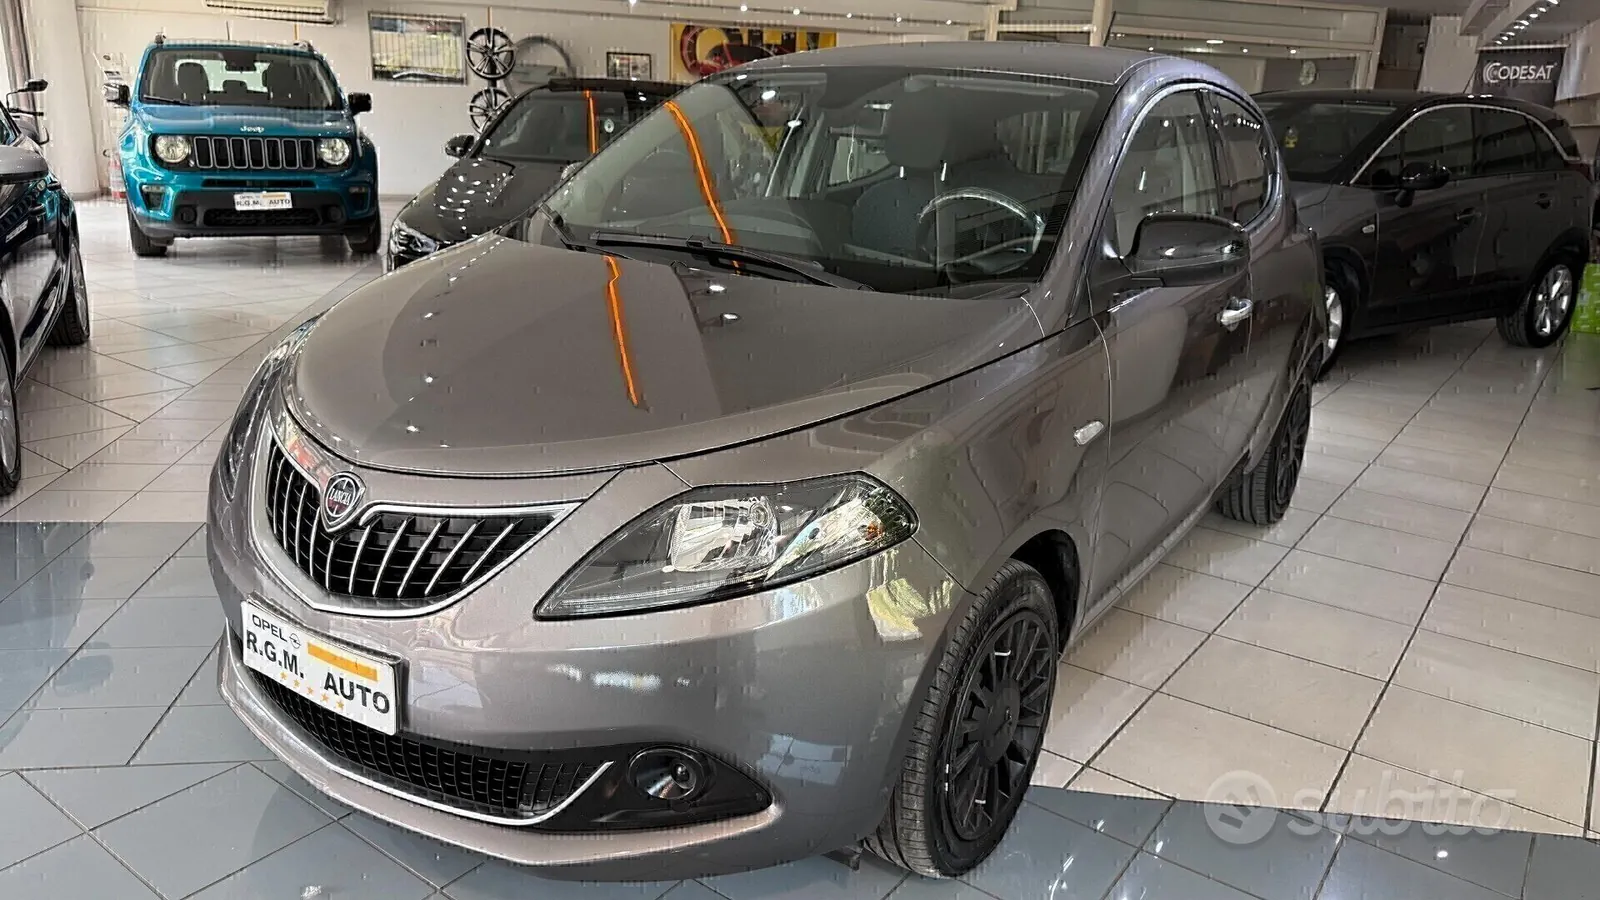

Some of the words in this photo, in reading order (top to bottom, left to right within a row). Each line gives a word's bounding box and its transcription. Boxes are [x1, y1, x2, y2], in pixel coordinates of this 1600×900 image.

[1483, 62, 1554, 83] CODESAT
[329, 488, 352, 506] LANCIA
[251, 614, 288, 643] OPEL
[246, 629, 305, 678] R.G.M.
[323, 671, 390, 714] AUTO
